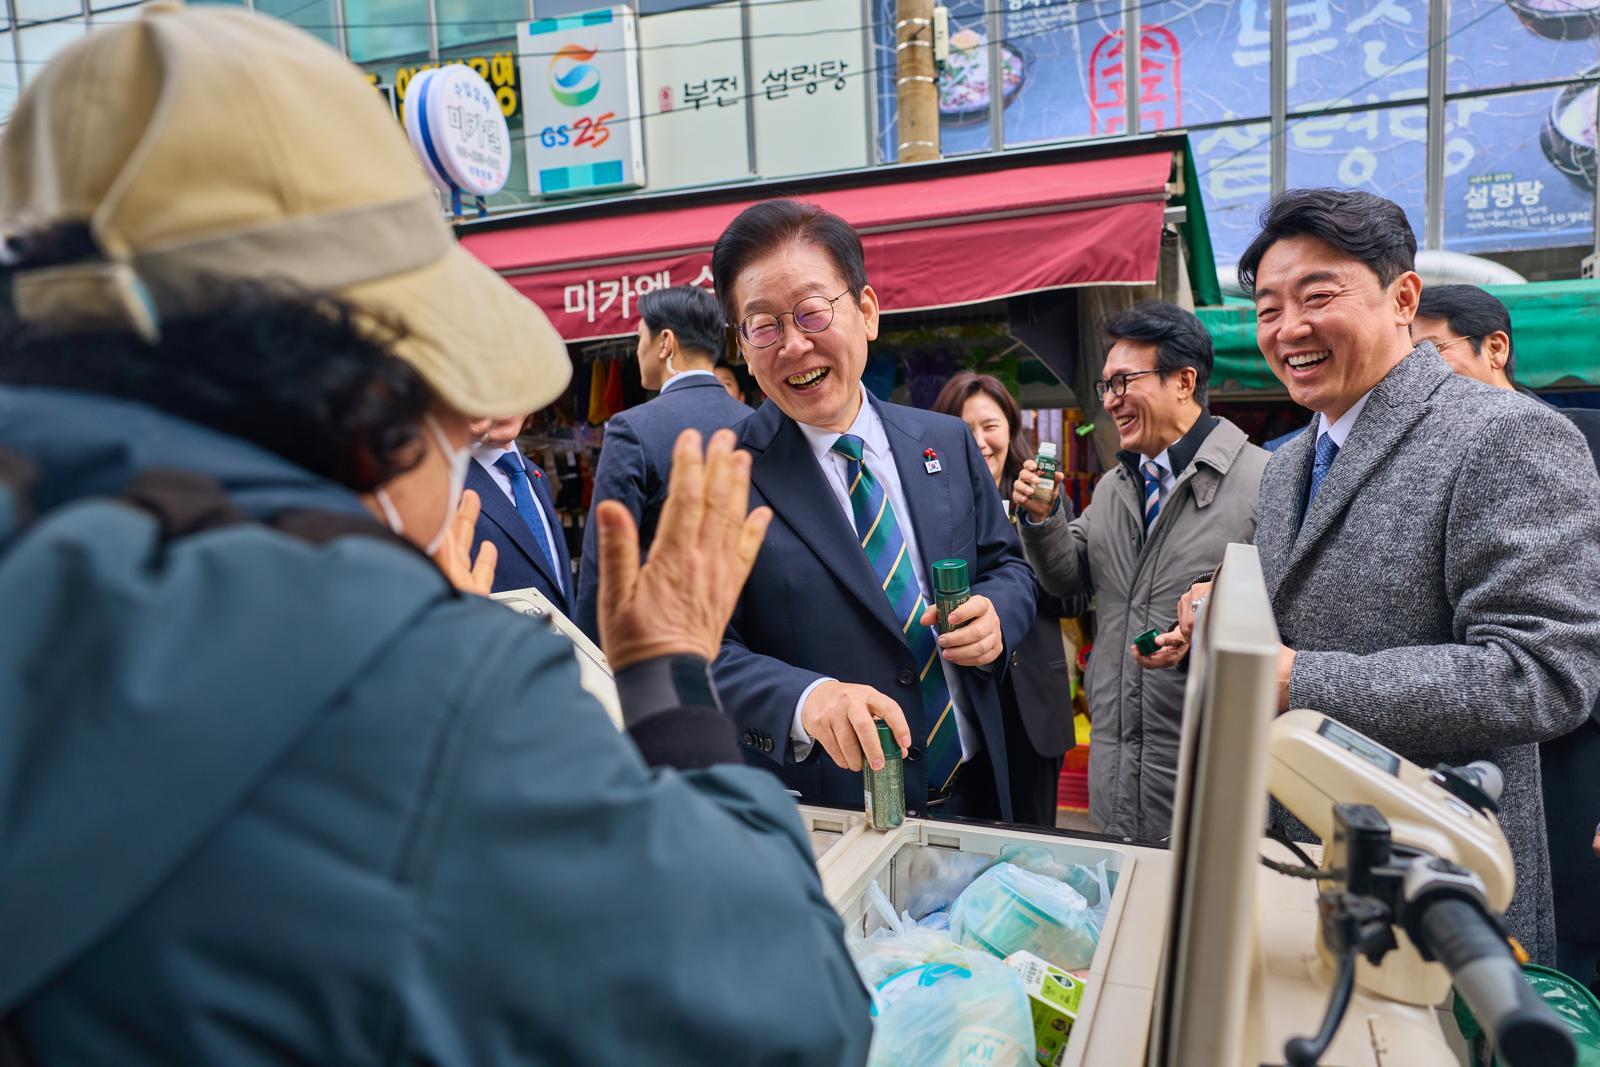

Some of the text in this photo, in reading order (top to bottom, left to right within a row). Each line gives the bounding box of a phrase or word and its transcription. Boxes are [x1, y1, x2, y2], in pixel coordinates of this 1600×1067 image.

[683, 76, 738, 110] 부전
[761, 60, 849, 100] 설렁탕
[1197, 83, 1488, 200] 설렁탕
[1464, 180, 1544, 210] 설렁탕
